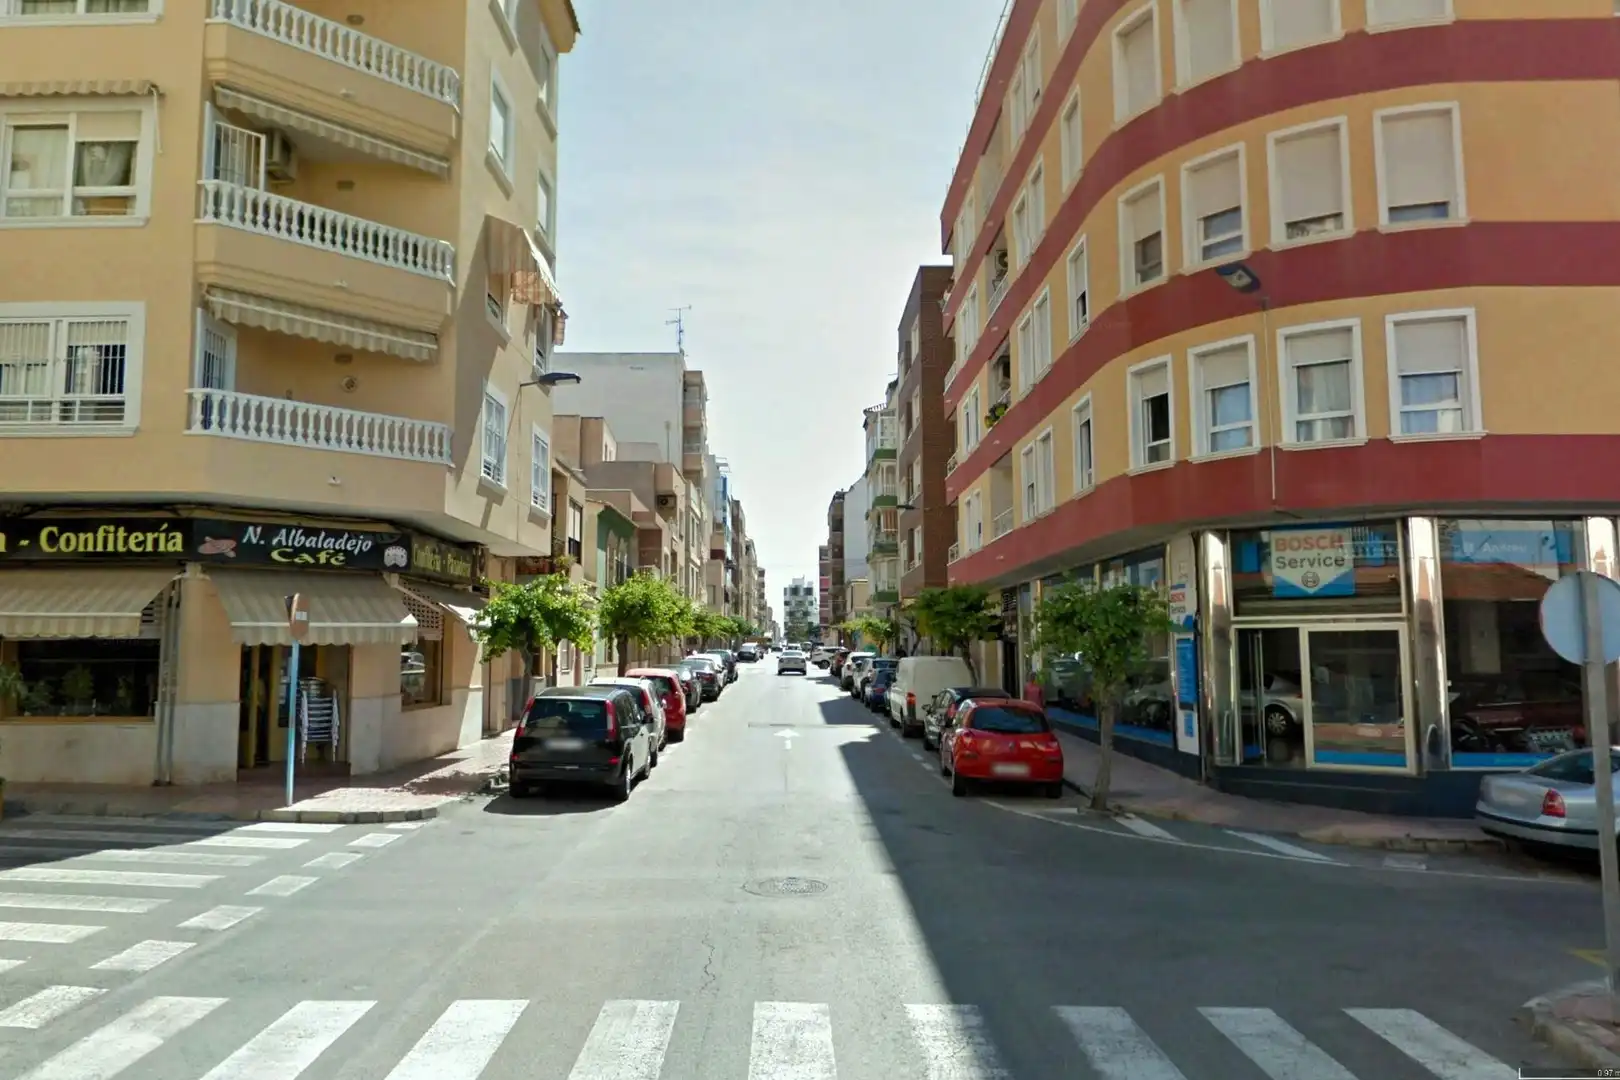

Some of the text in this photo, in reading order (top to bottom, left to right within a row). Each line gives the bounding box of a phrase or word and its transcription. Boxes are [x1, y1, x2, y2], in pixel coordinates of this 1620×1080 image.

[39, 522, 184, 552] Confitería
[241, 525, 373, 555] N. Albaladejo
[1274, 534, 1344, 552] BOSCH
[270, 548, 346, 566] Café
[1276, 553, 1346, 570] Service
